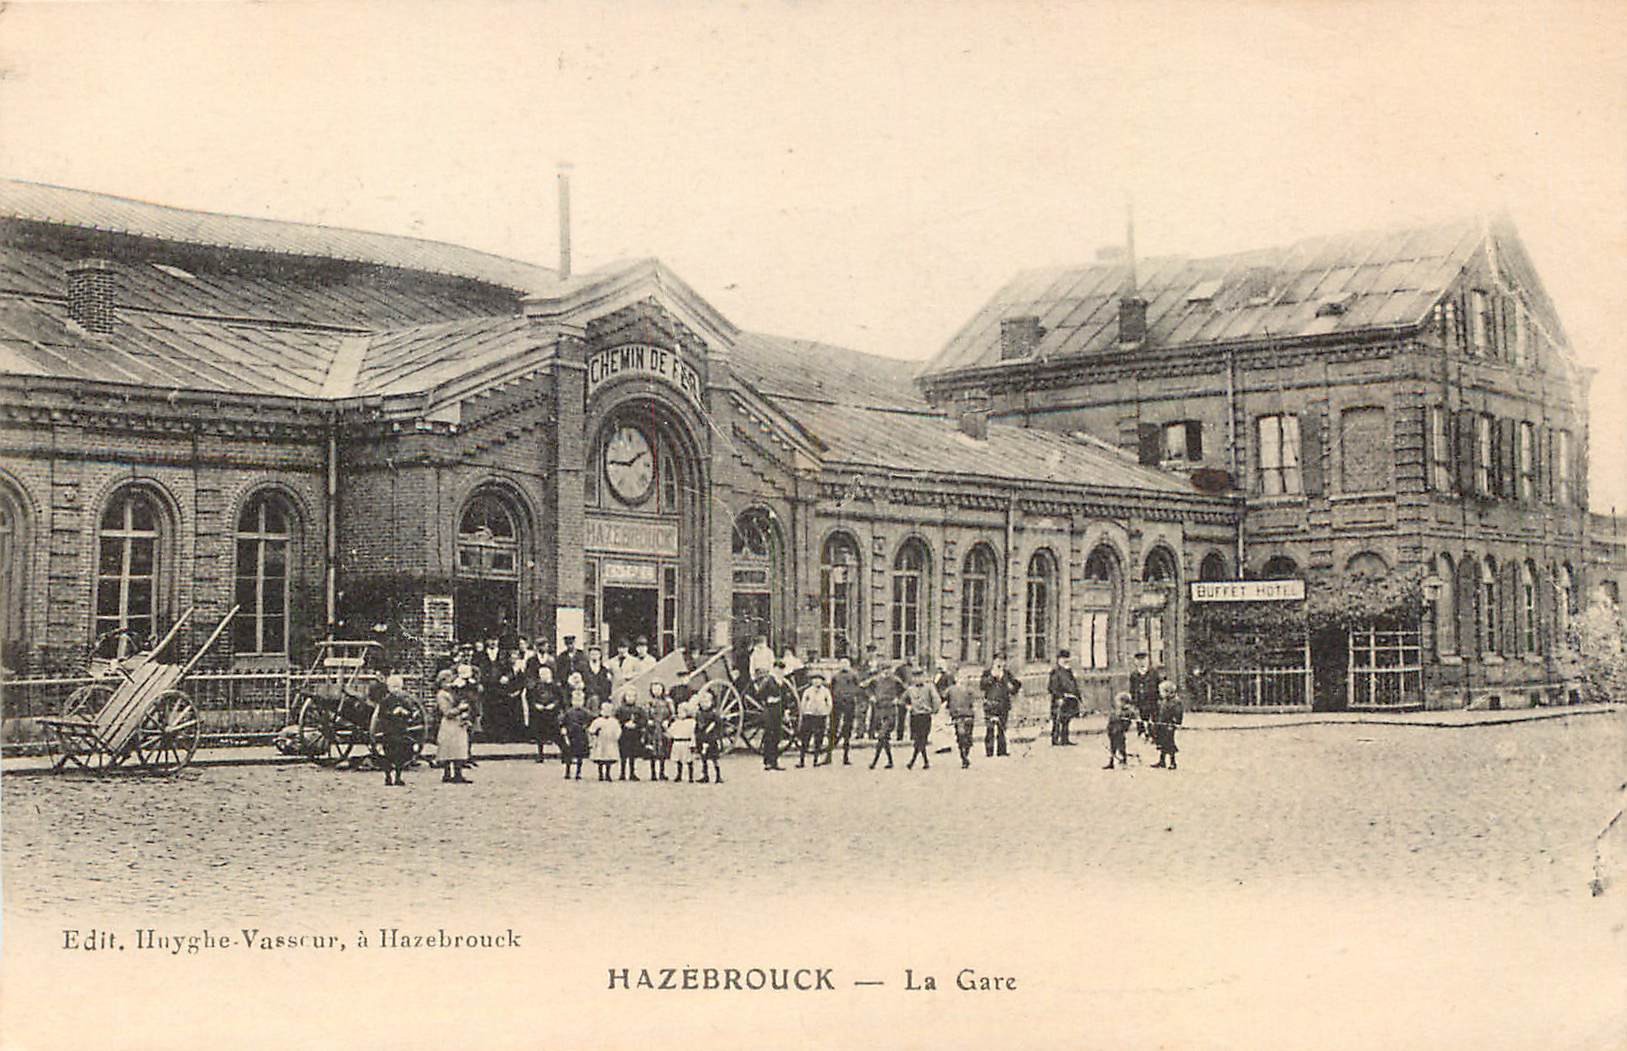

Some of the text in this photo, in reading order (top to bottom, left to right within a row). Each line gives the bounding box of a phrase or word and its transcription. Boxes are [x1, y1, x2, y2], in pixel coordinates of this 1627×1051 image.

[591, 347, 699, 397] CHEMIN DE FER
[1197, 584, 1298, 598] BUFFET HOTEL
